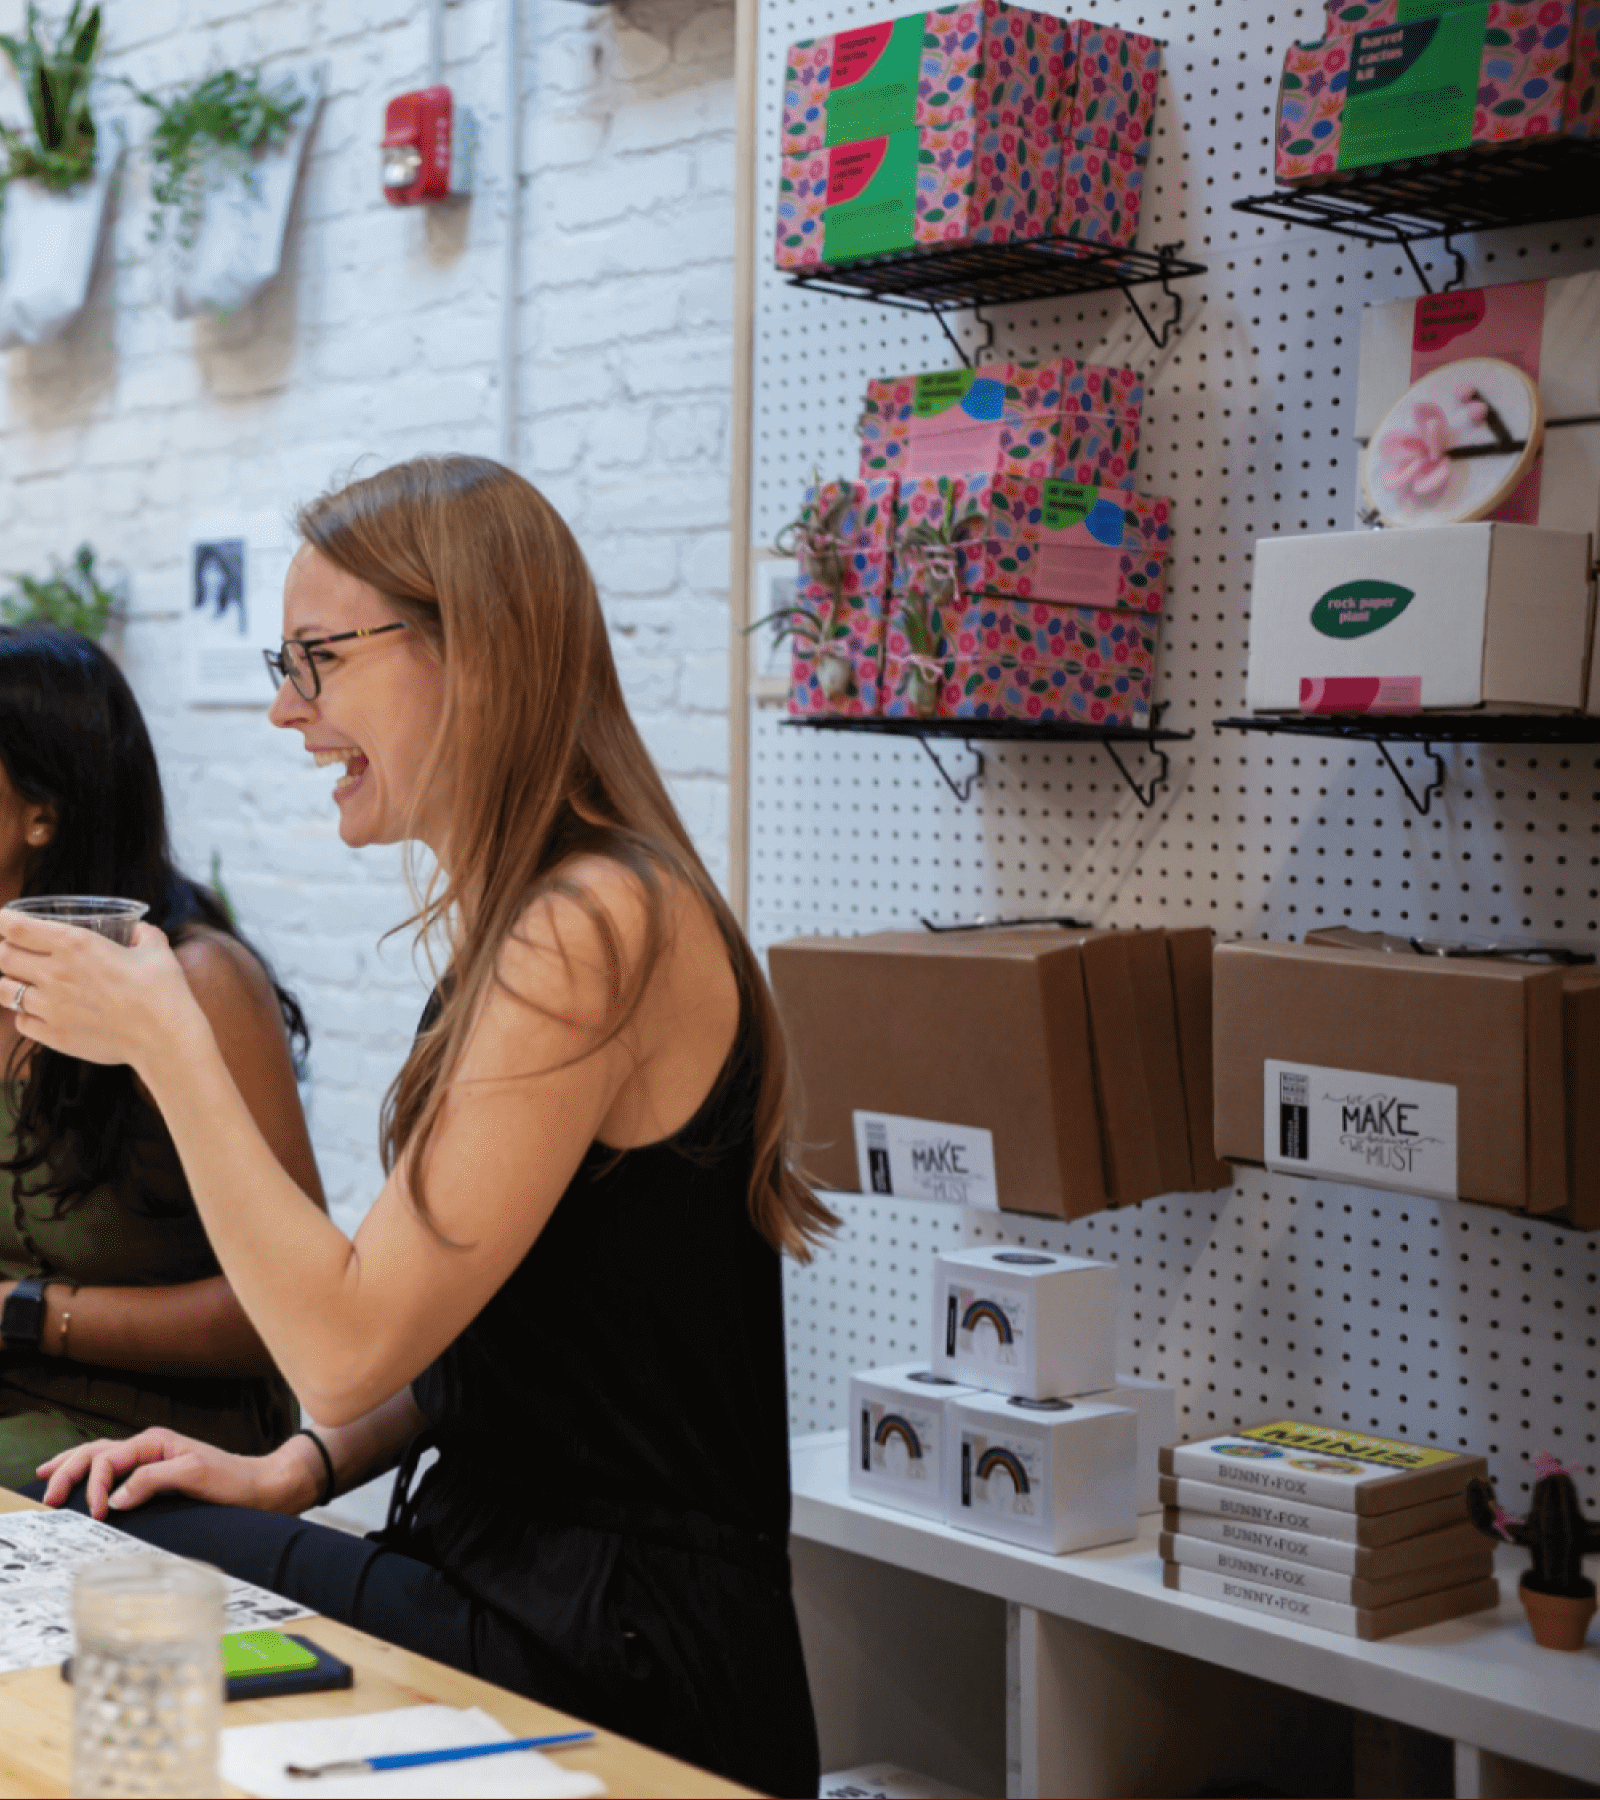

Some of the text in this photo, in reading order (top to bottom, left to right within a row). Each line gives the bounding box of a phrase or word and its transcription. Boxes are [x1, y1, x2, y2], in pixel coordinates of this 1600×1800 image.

[1360, 29, 1404, 48] barrel
[1358, 48, 1403, 65] cactus
[1356, 67, 1376, 81] kit
[1327, 597, 1397, 610] rock paper
[1338, 610, 1370, 625] plant
[1342, 1096, 1420, 1137] MAKE
[911, 1140, 970, 1174] MAKE
[1366, 1145, 1423, 1173] MUST
[1262, 1429, 1424, 1464] MINIS
